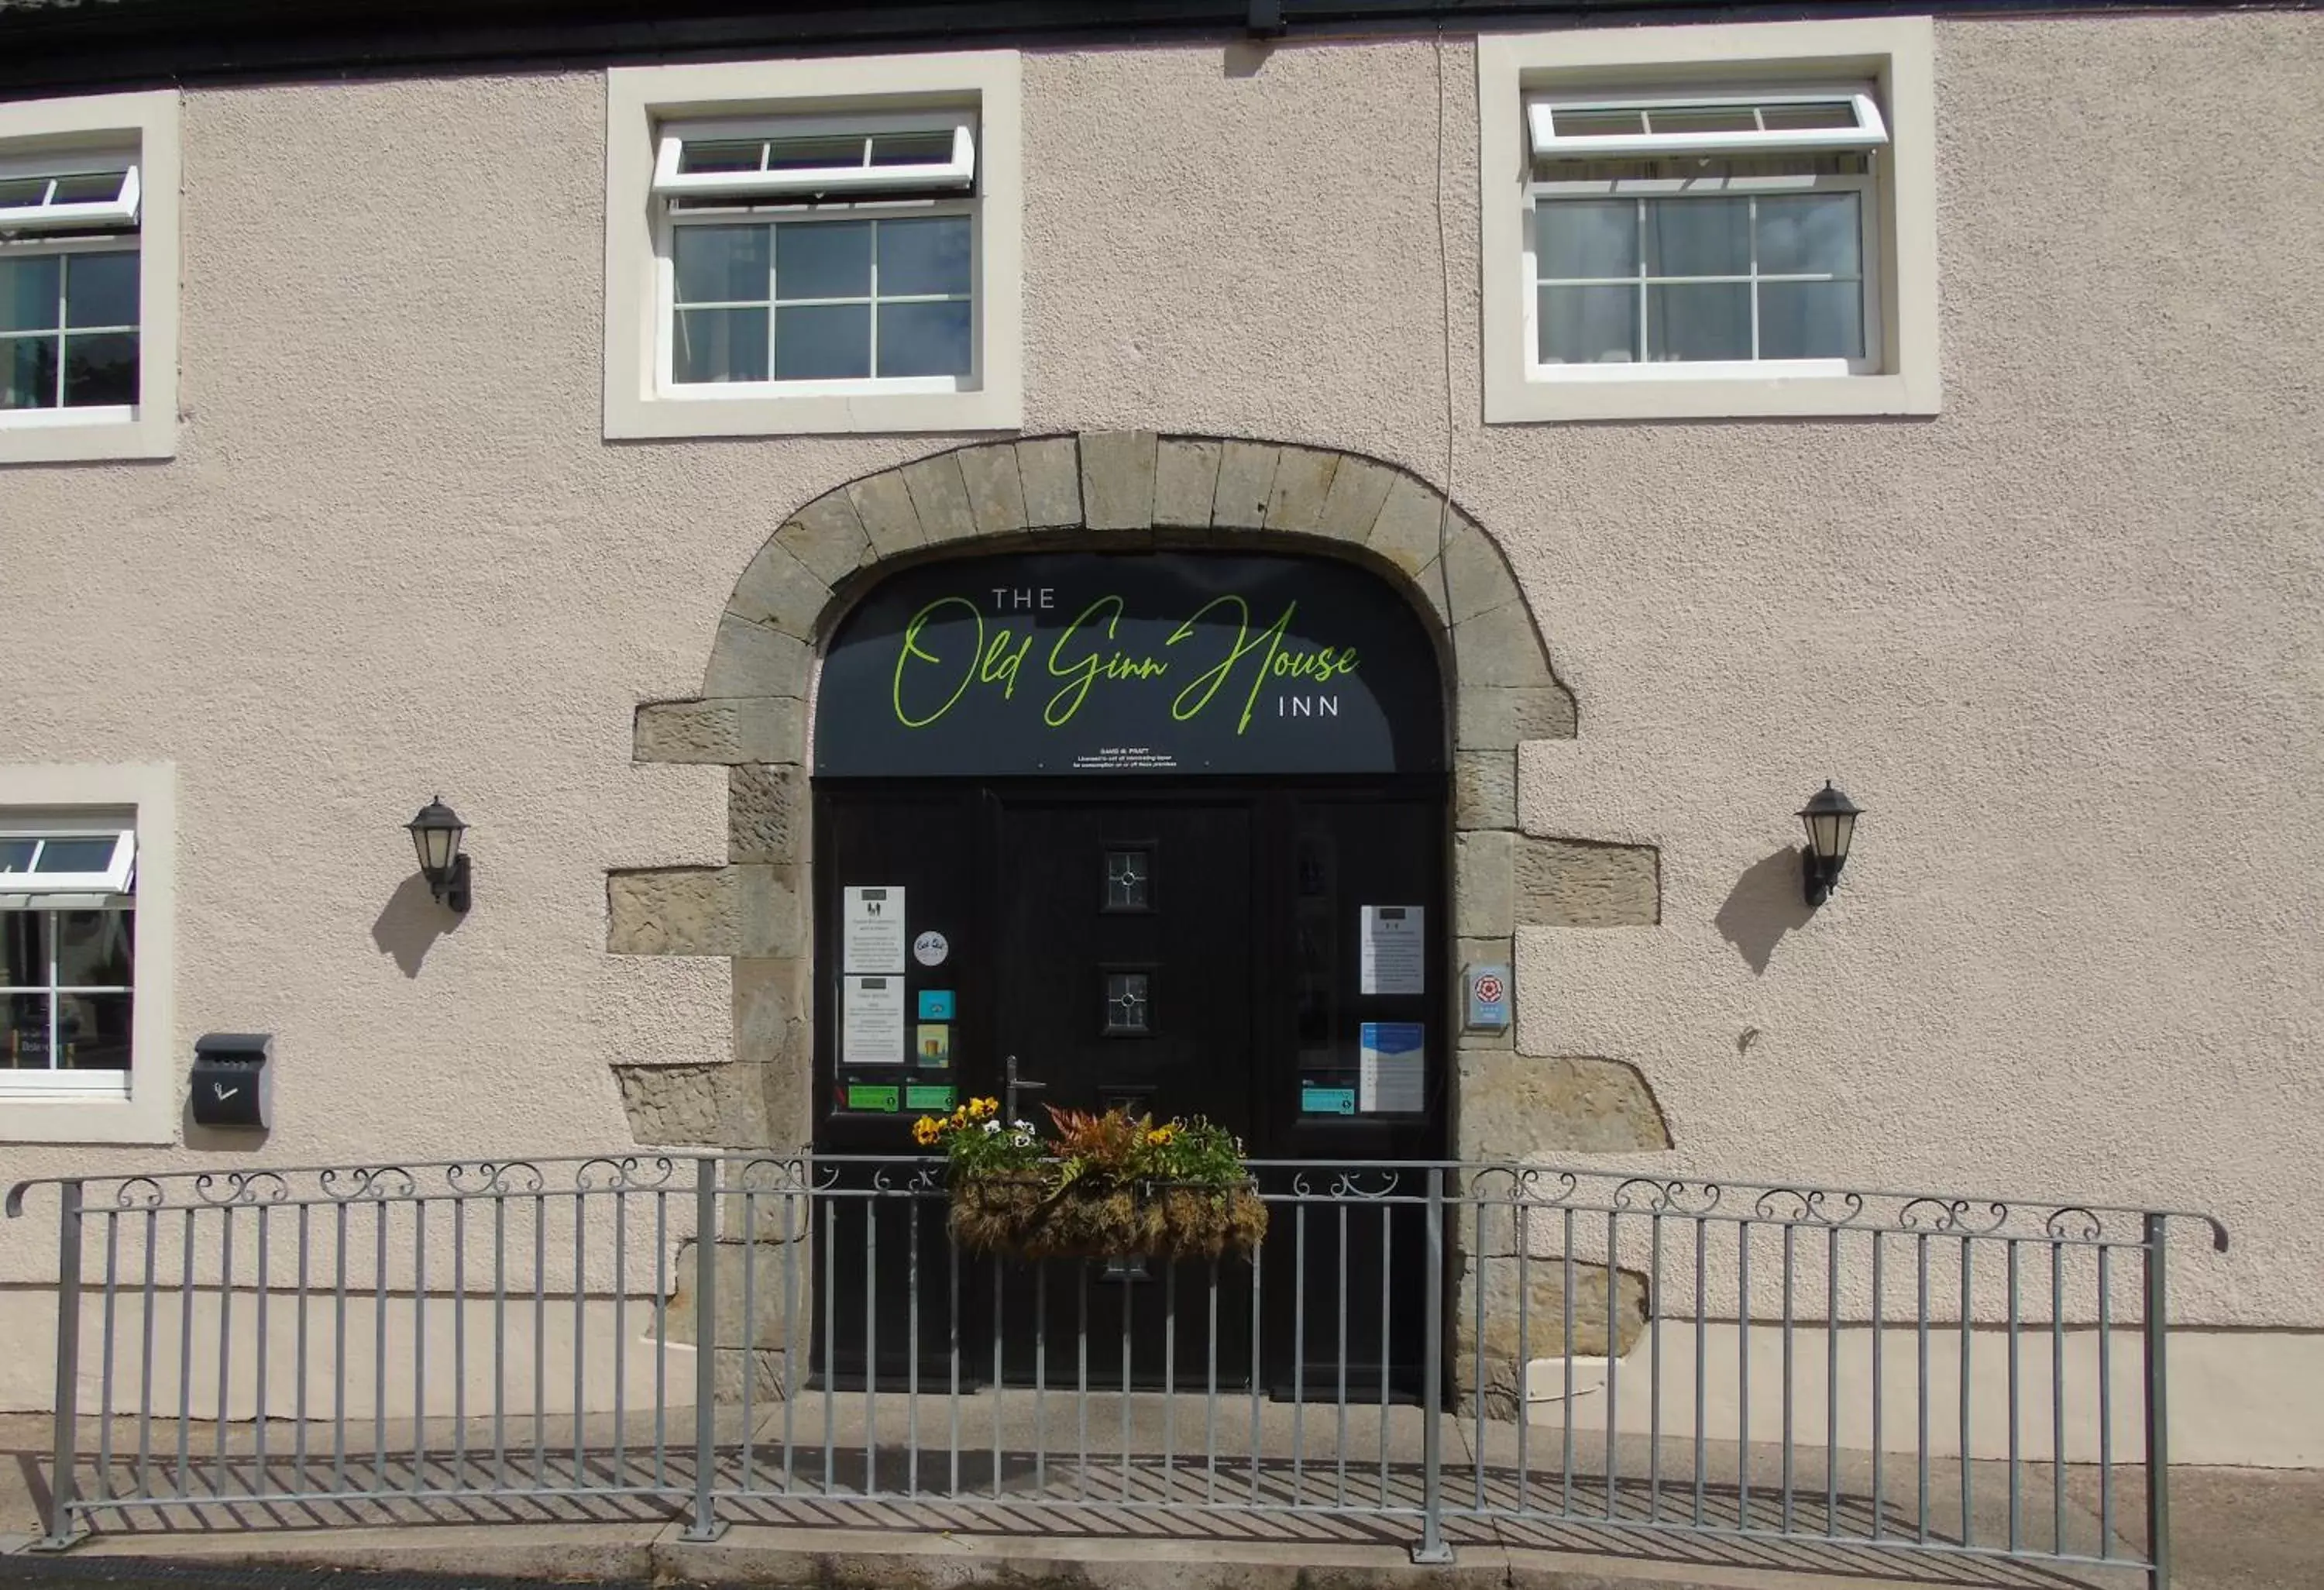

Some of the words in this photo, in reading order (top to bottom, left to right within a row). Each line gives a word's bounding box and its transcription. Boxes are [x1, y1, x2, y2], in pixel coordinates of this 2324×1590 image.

[992, 588, 1054, 608] THE
[893, 597, 1033, 728] Old
[1044, 594, 1168, 726] Ginn
[1165, 594, 1361, 735] House
[1279, 696, 1339, 716] INN
